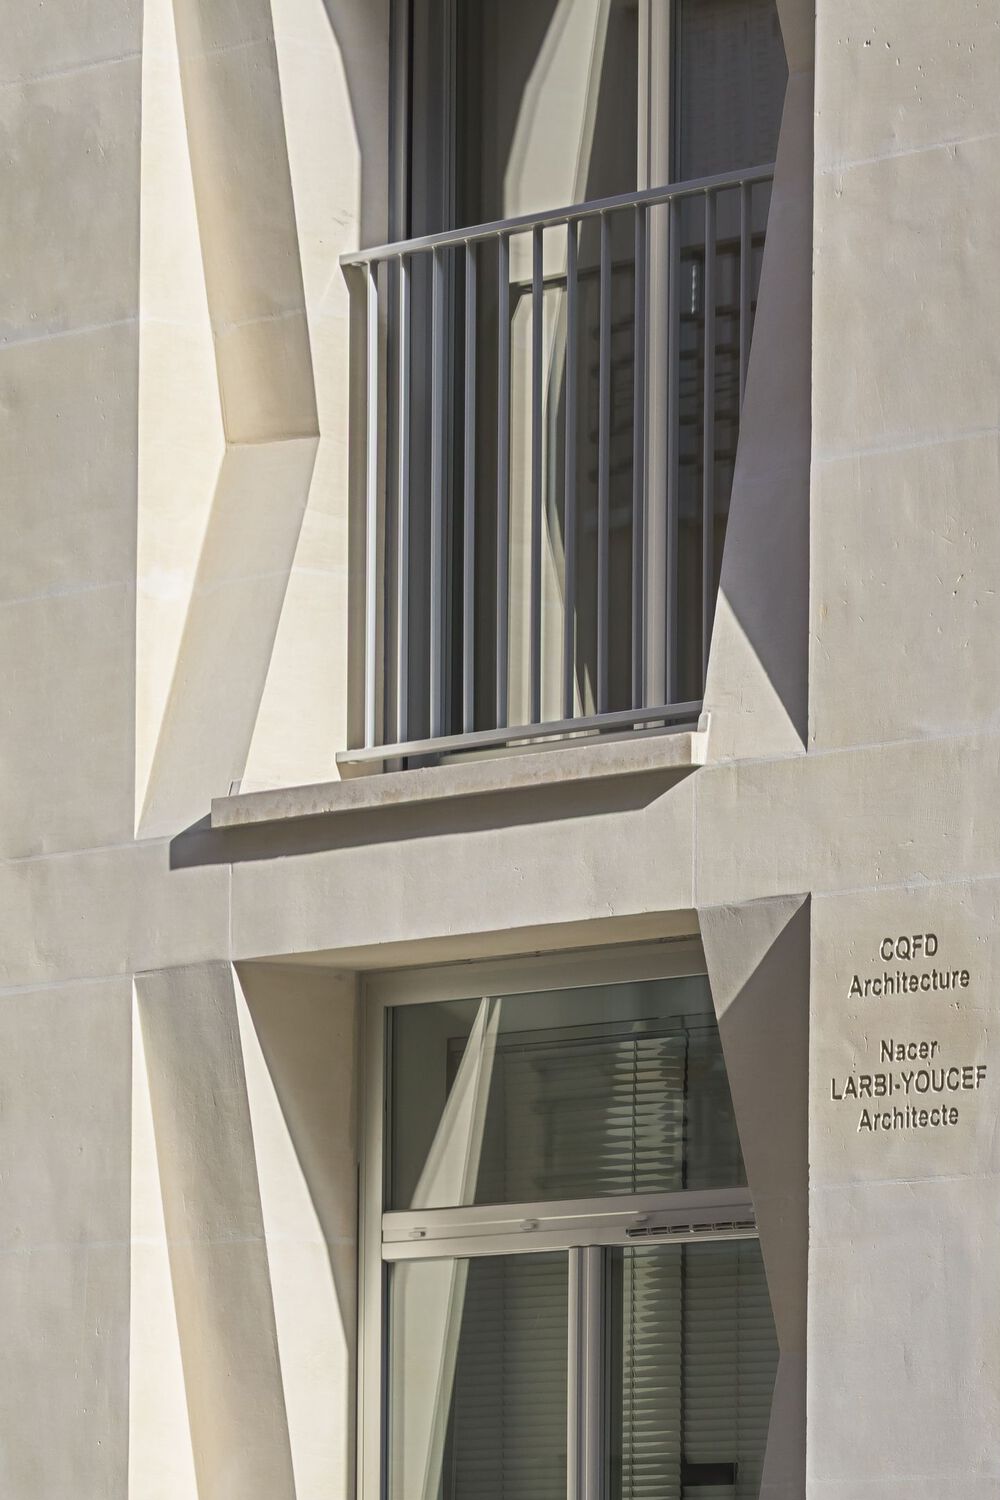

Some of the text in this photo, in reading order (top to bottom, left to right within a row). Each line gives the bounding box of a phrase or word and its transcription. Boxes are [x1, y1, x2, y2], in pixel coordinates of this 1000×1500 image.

[880, 933, 938, 962] CQFD
[848, 968, 970, 999] Architecture
[880, 1038, 938, 1063] Nacer
[831, 1065, 987, 1101] LARBI-YOUCEF
[857, 1104, 959, 1133] Architecte
